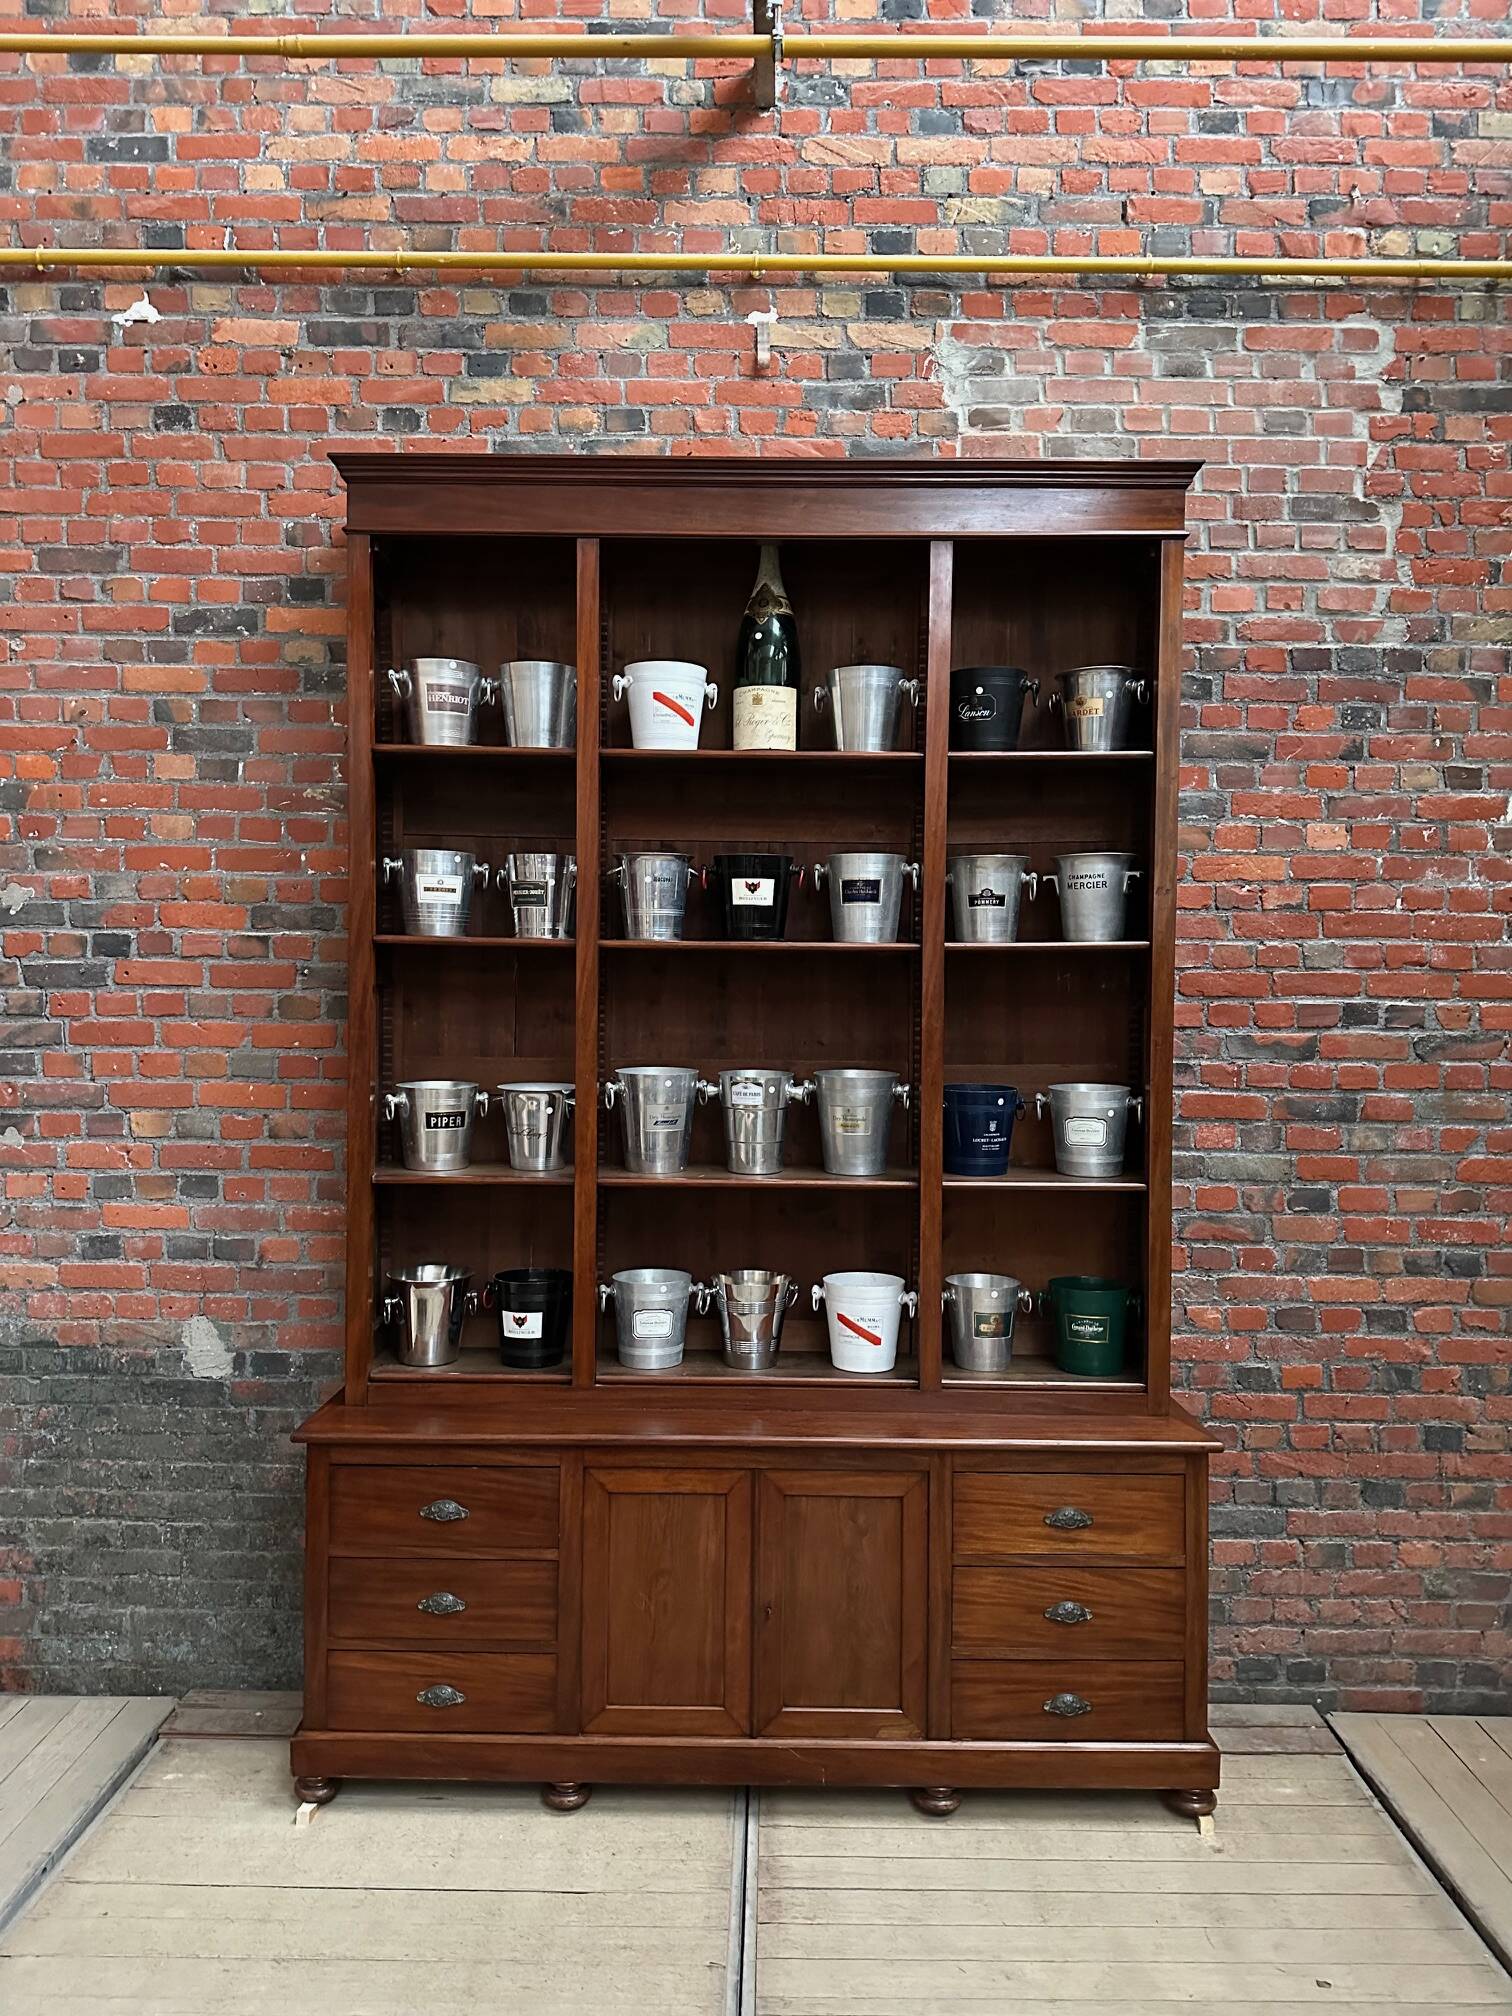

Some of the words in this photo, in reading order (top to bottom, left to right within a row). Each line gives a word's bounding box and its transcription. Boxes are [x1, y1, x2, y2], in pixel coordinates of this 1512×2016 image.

[738, 687, 780, 697] CHAMPAGNE
[428, 694, 469, 705] HENRIOT
[959, 703, 992, 720] Lanson
[1068, 872, 1106, 881] CHAMPAGNE
[1067, 880, 1108, 890] MERCIER
[430, 1116, 462, 1128] PIPER
